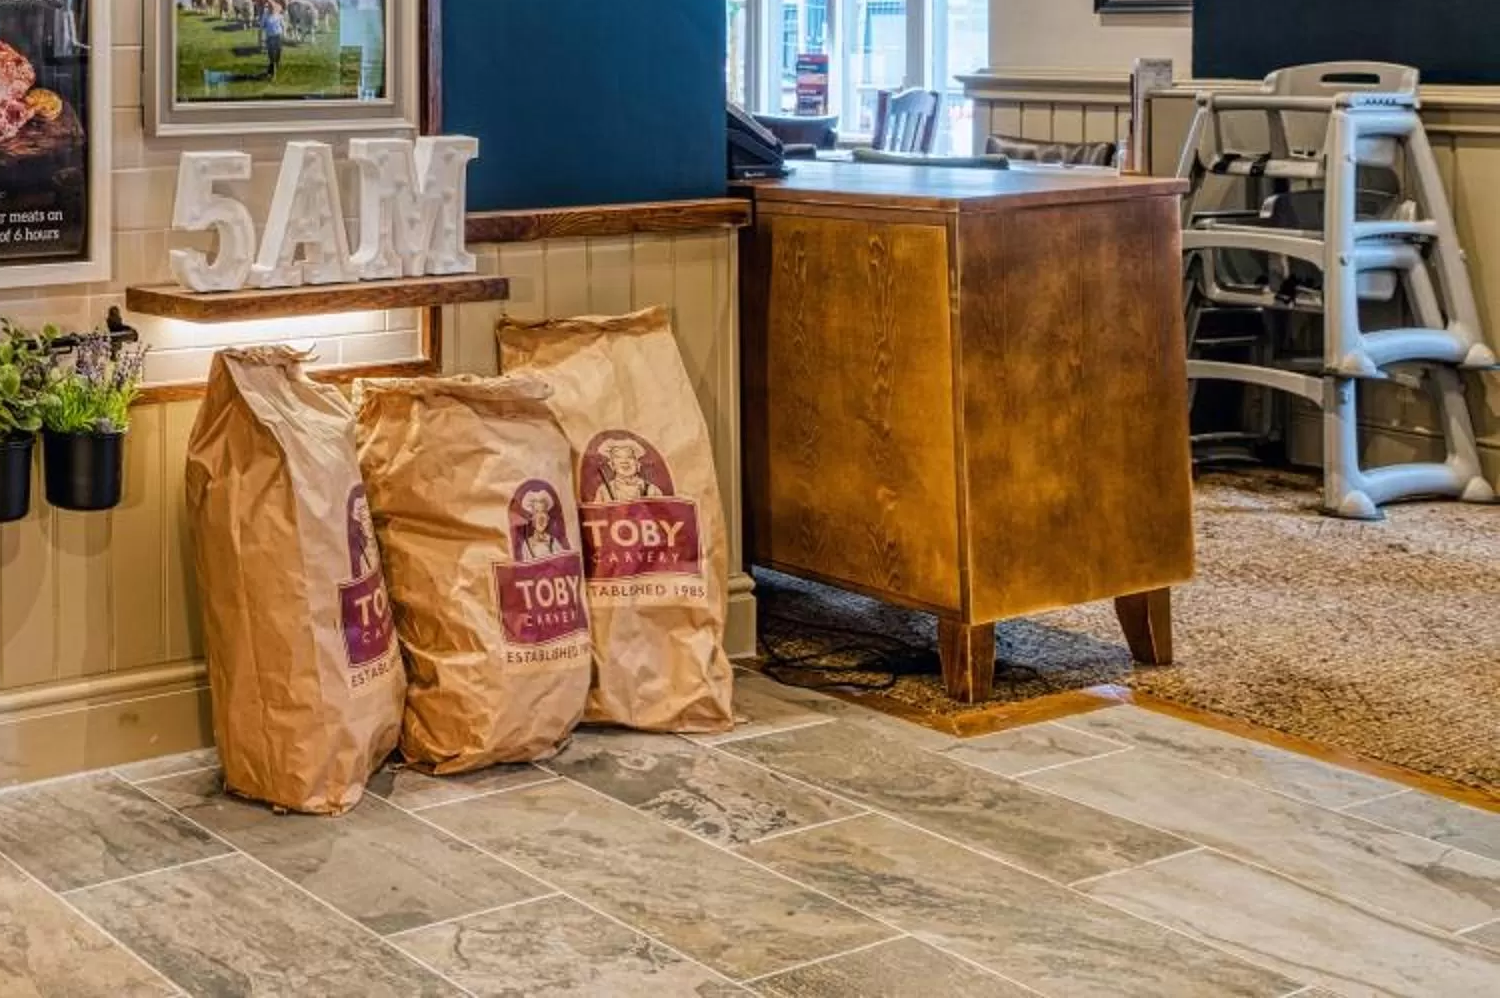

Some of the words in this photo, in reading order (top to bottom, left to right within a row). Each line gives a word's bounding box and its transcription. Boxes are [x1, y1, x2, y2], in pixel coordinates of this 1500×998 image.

[9, 210, 44, 223] meats
[47, 210, 63, 221] on
[169, 135, 479, 293] 5AM
[14, 229, 22, 241] 6
[25, 228, 59, 241] hours
[583, 519, 684, 547] TOBY
[516, 575, 579, 610] TOBY
[587, 584, 666, 597] TABLISHED
